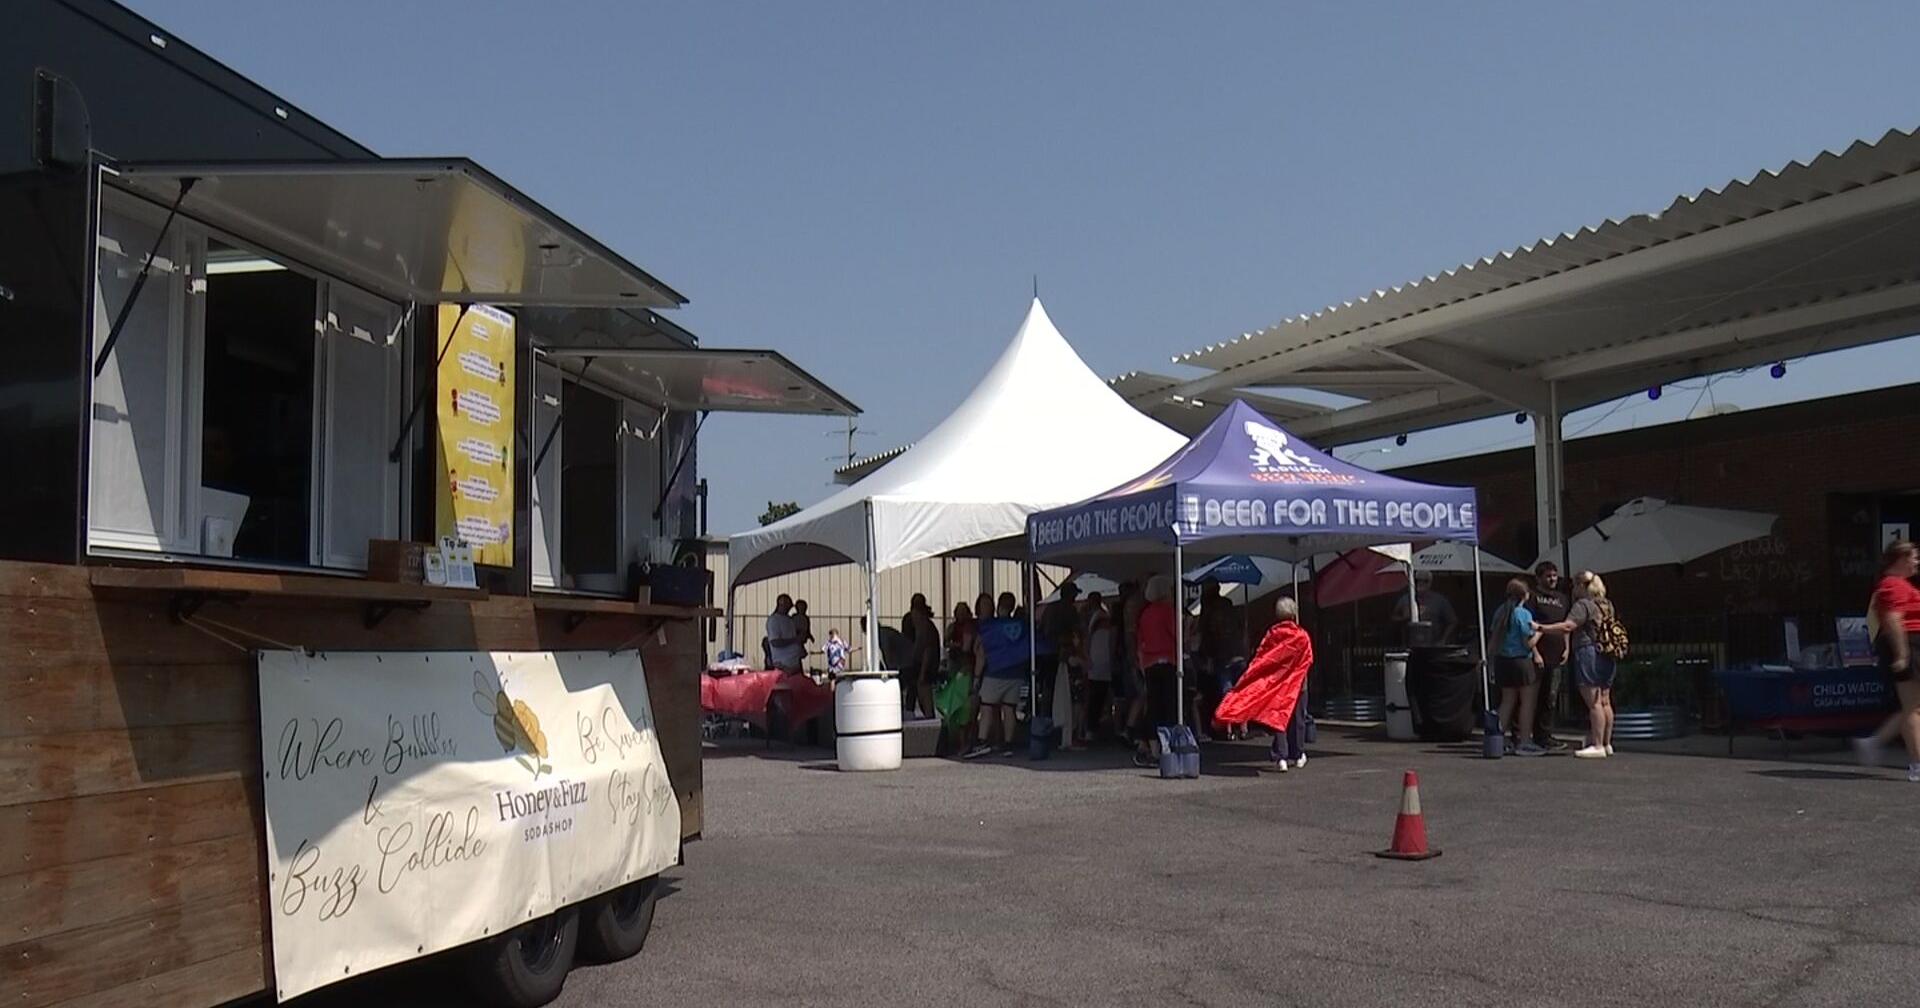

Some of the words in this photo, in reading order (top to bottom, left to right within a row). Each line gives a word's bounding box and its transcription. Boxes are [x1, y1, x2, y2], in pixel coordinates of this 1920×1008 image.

[1038, 519, 1064, 546] BEER
[1066, 511, 1090, 541] FOR
[1094, 509, 1118, 535] THE
[1120, 499, 1174, 533] PEOPLE
[1205, 498, 1266, 527] BEER
[1273, 498, 1326, 526] FOR
[1336, 500, 1379, 527] THE
[1385, 501, 1473, 529] PEOPLE
[1813, 683, 1846, 697] CHILD
[279, 717, 375, 781] Where
[383, 711, 458, 775] Bubbles
[577, 710, 606, 764] Be
[363, 776, 384, 826] &
[279, 838, 370, 922] Buzz
[377, 806, 489, 895] Collide
